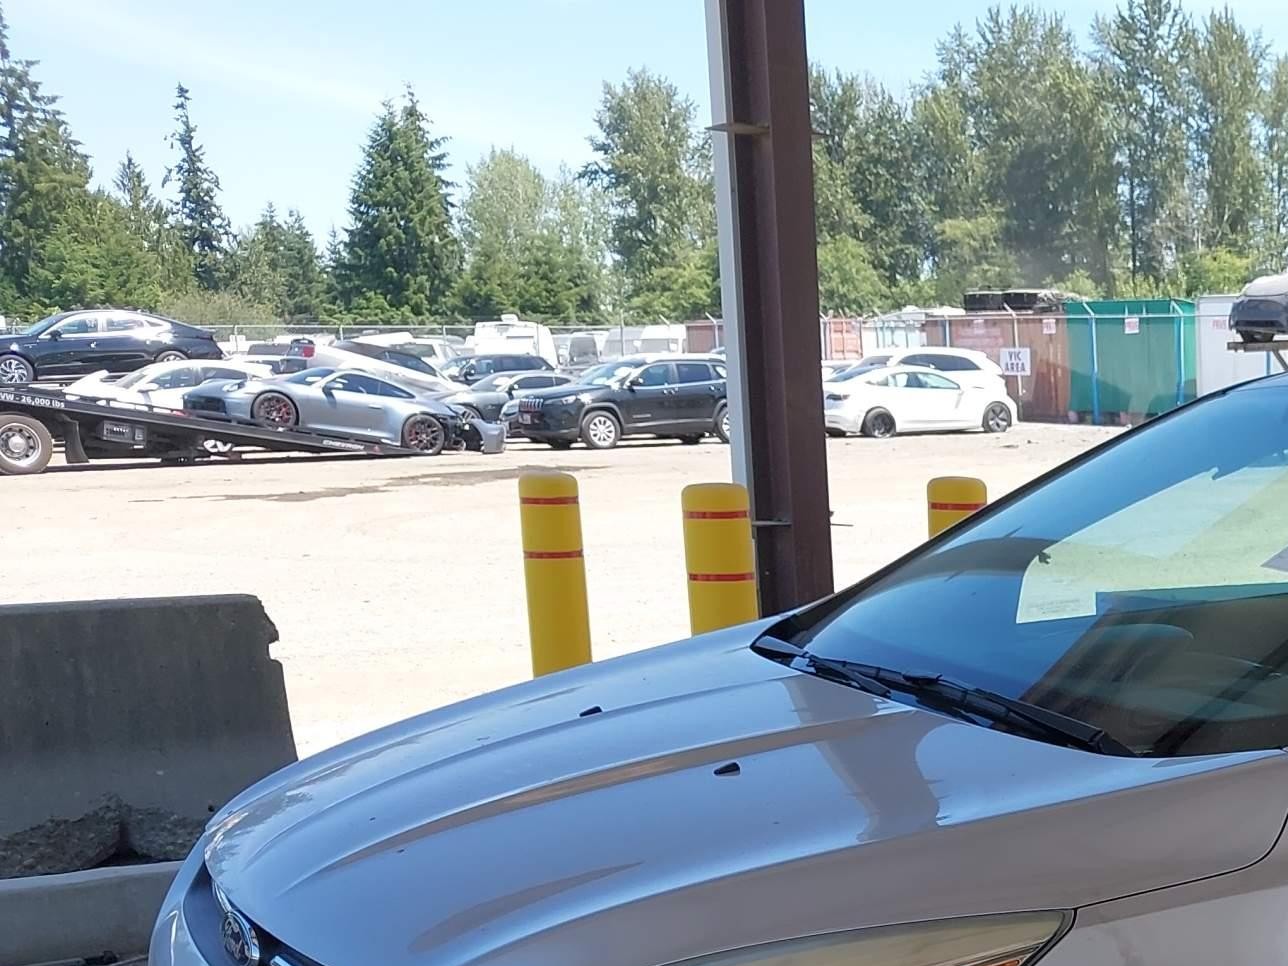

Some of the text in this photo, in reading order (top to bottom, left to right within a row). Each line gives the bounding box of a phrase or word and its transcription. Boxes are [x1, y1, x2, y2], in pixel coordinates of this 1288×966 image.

[1007, 351, 1022, 361] VIC
[1005, 362, 1026, 372] AREA
[21, 395, 50, 406] 26,000
[52, 399, 65, 408] lbs
